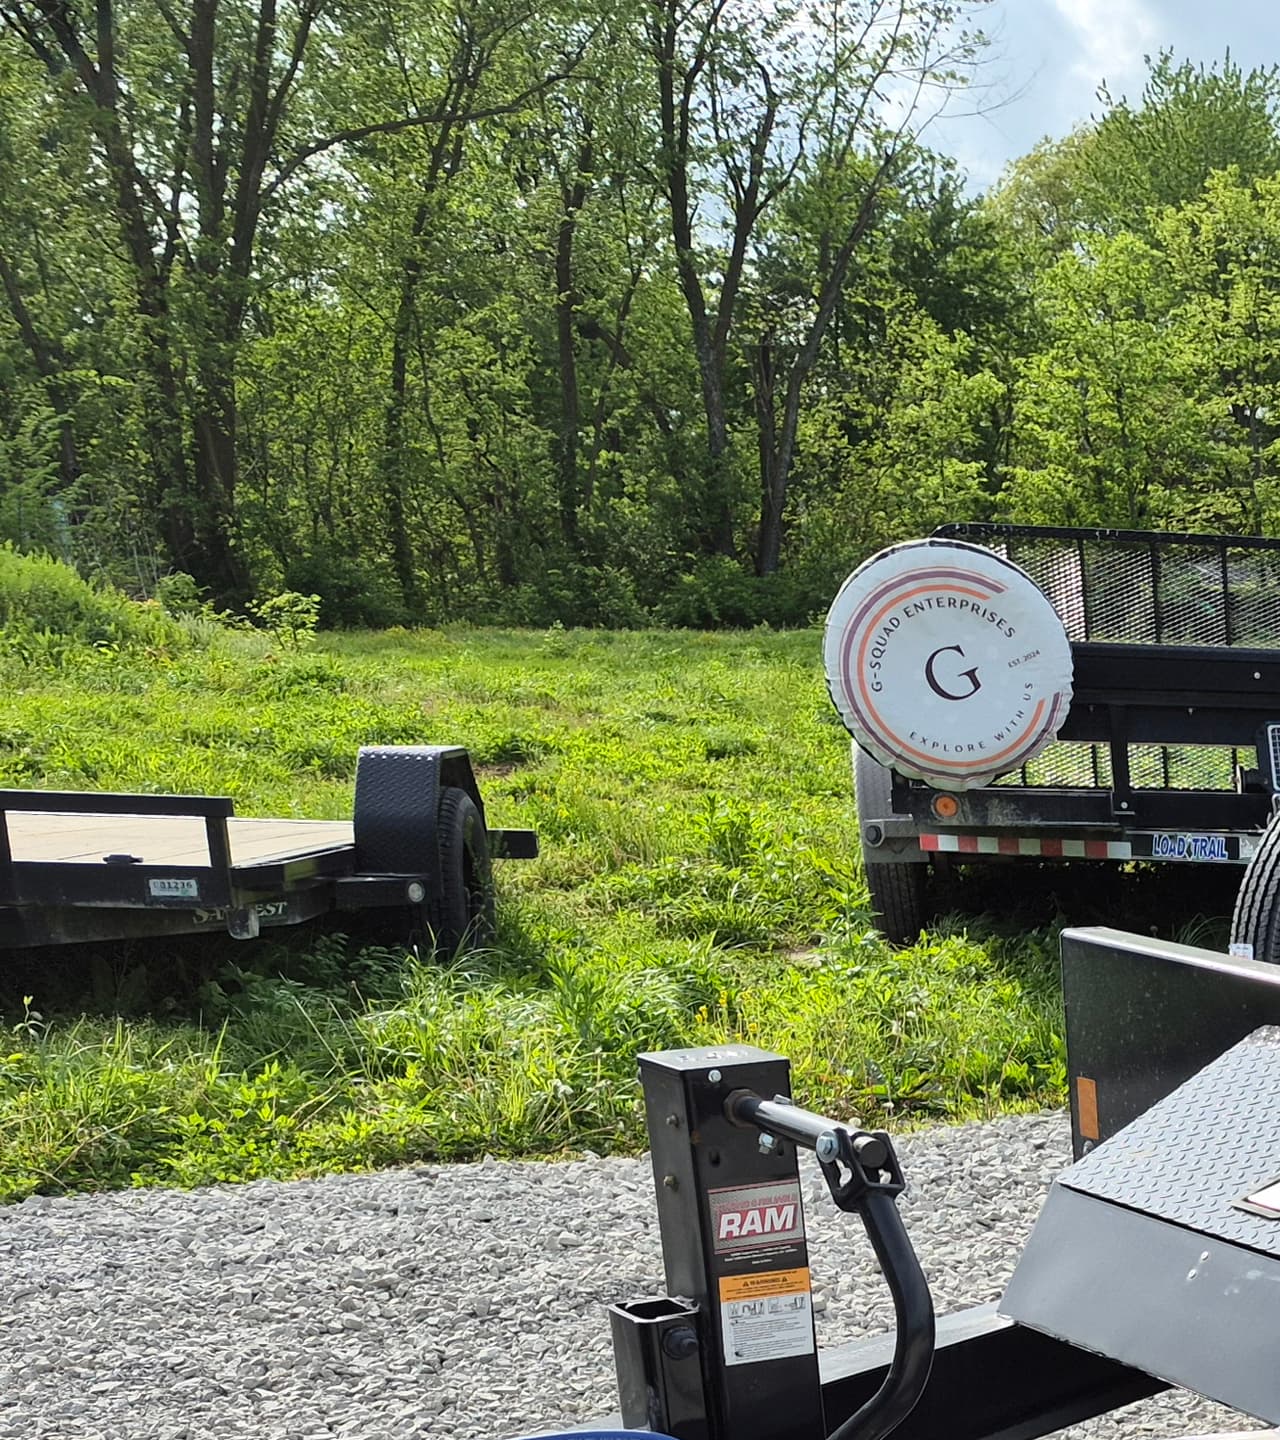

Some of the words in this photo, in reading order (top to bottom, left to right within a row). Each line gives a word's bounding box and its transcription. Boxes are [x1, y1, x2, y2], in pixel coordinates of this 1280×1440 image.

[870, 616, 901, 693] G-SQUAD
[903, 596, 1017, 639] ENTERPRISES
[1023, 649, 1041, 662] 2024
[924, 644, 983, 701] G
[909, 730, 987, 753] EXPLORE
[994, 709, 1025, 742] WITH
[1023, 682, 1034, 702] US
[1152, 833, 1186, 857] LOAD
[1192, 836, 1229, 860] TRAIL
[718, 1204, 796, 1239] RAM
